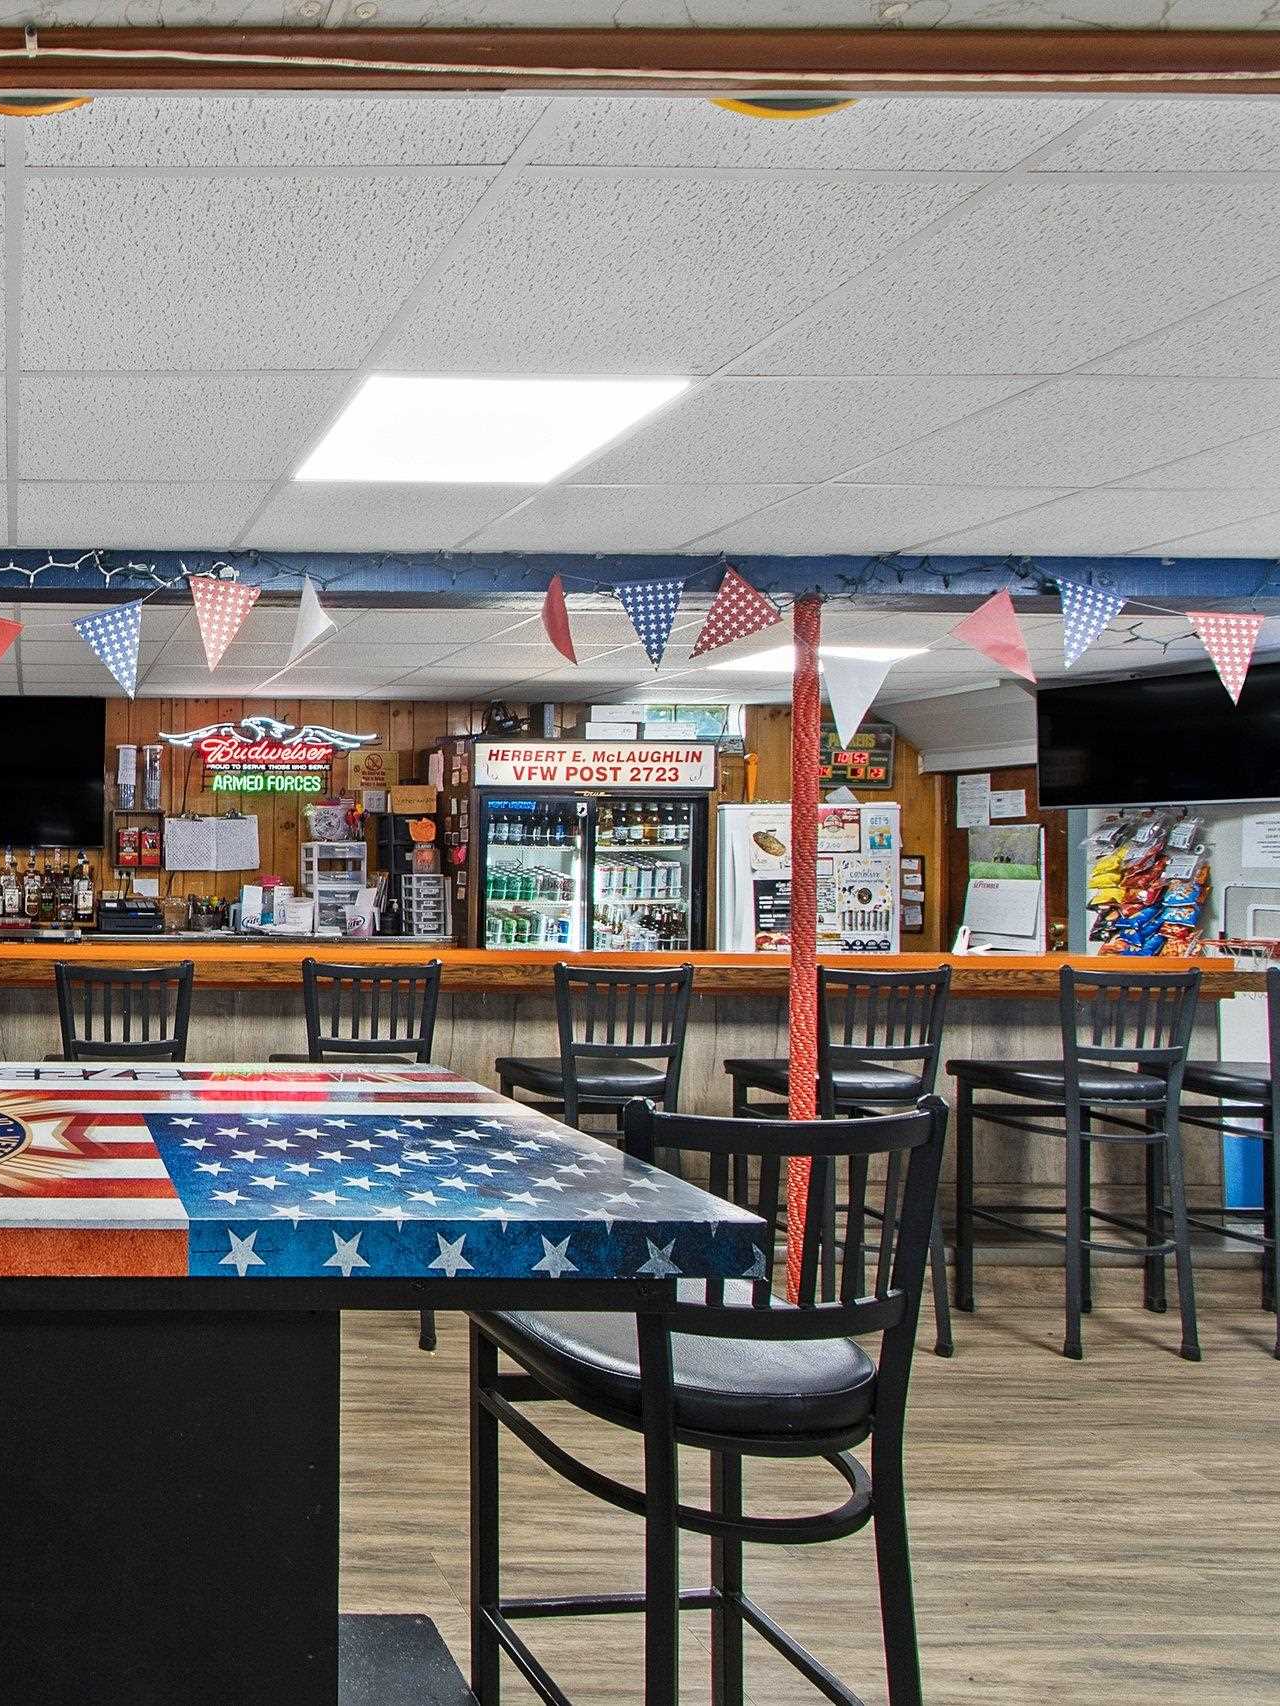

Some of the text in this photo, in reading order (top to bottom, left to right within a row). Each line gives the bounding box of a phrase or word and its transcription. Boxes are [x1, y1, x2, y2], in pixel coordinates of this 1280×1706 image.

[201, 738, 332, 763] Budweiser
[488, 749, 702, 763] HERBERT E. McLAUGHLIN
[513, 766, 680, 782] VFW POST 2723
[213, 774, 322, 792] ARMED FORCES
[973, 880, 1000, 889] SEPTEMBER
